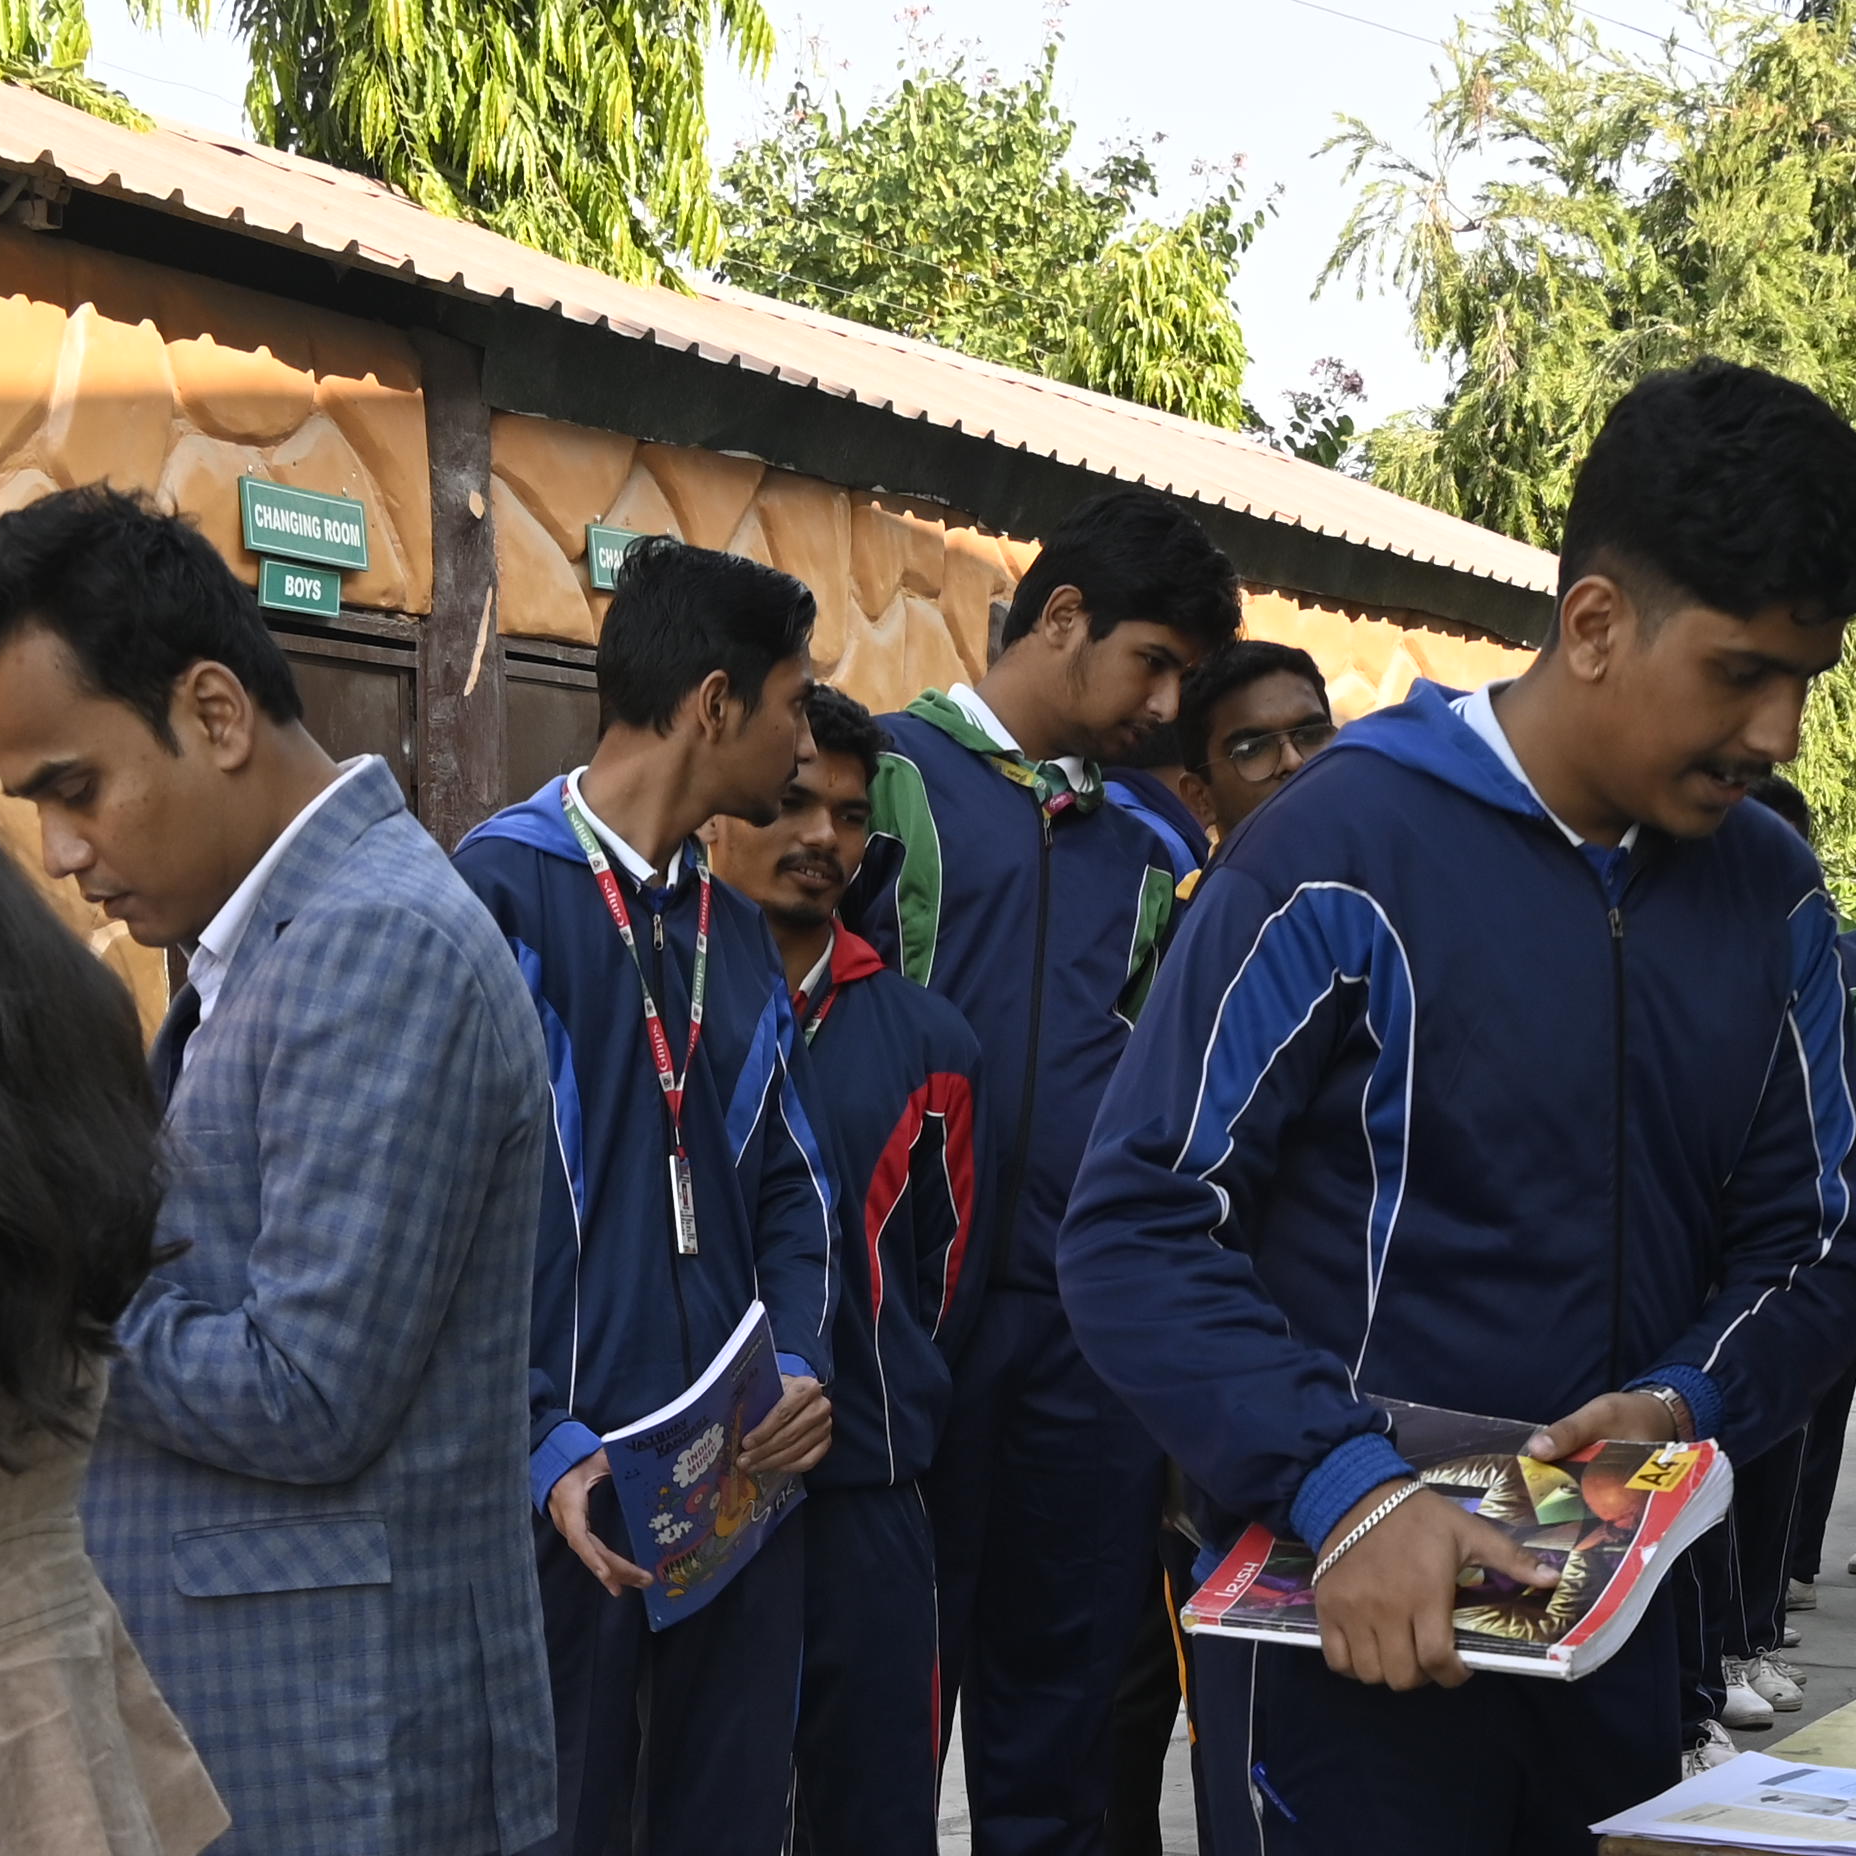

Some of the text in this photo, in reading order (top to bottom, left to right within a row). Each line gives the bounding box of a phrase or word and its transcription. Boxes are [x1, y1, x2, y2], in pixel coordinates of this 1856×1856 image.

[254, 503, 361, 547] CHANGING ROOM
[284, 574, 321, 600] BOYS
[686, 1437, 713, 1466] INDIA
[1638, 1453, 1676, 1488] A4
[1213, 1561, 1260, 1600] IRISH
